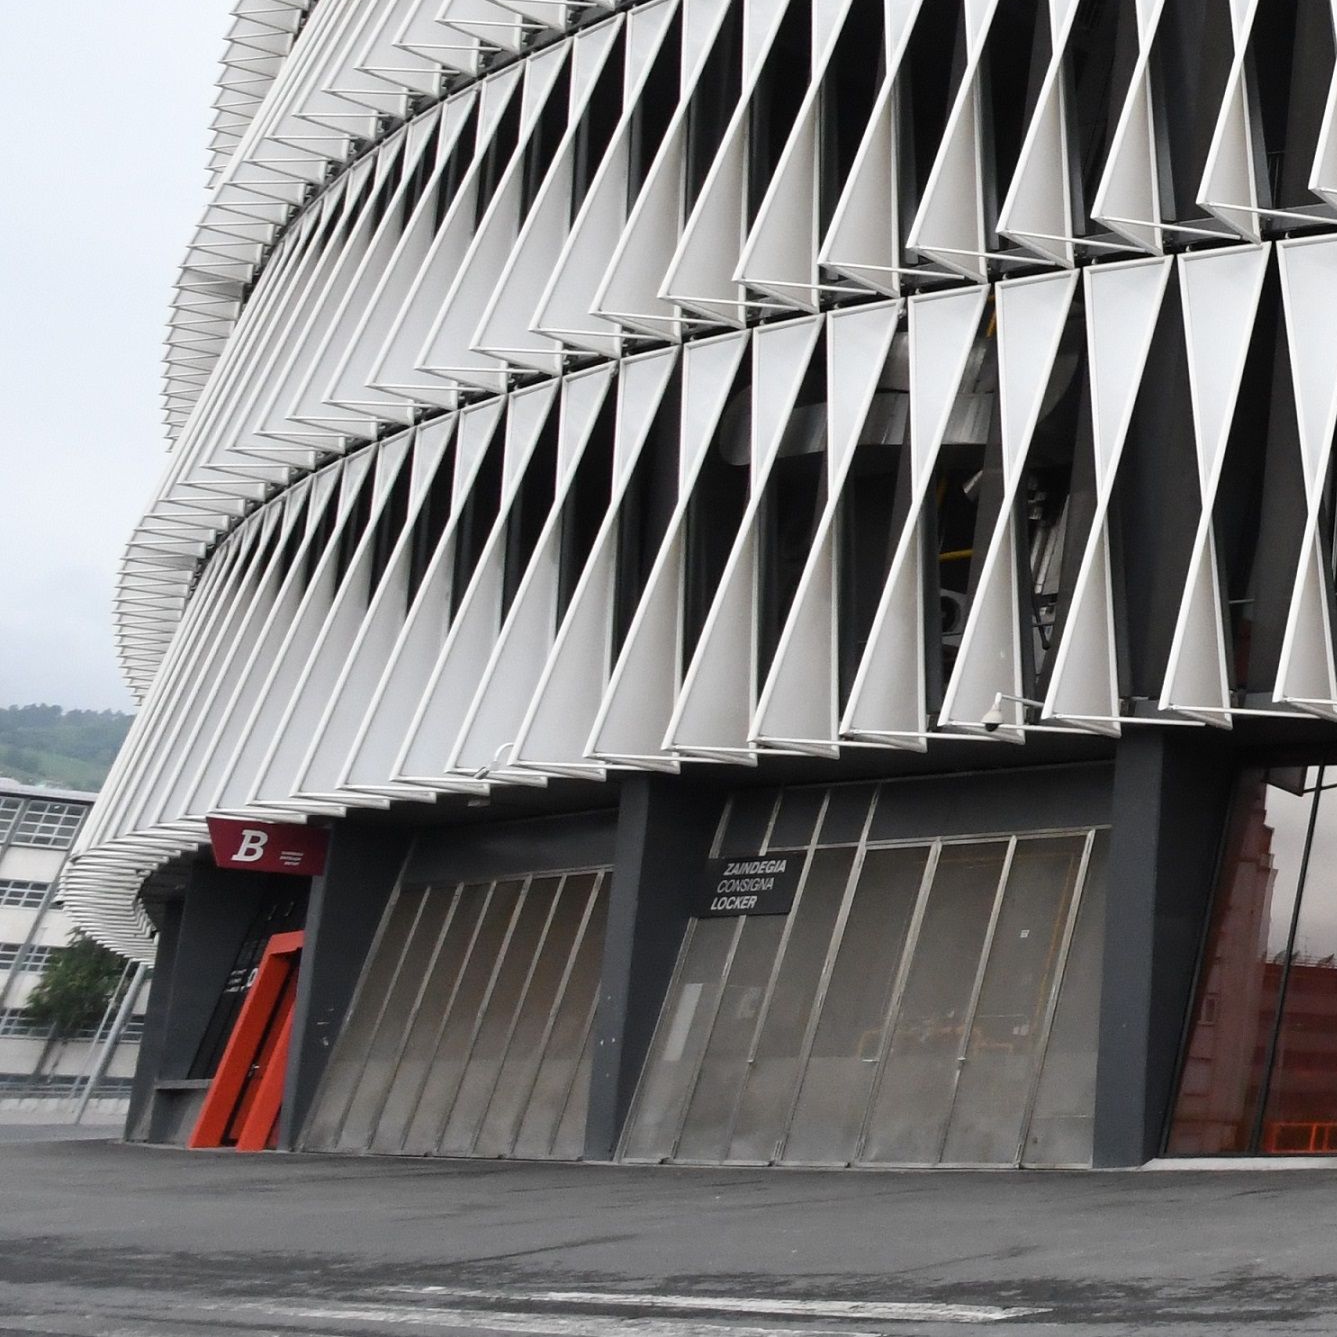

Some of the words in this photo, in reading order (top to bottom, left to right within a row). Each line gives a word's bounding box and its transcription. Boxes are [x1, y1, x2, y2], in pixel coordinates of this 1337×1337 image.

[231, 828, 269, 862] B
[723, 860, 787, 876] ZAINDEGIA
[717, 877, 775, 894] CONSIGNA
[710, 895, 758, 911] LOCKER
